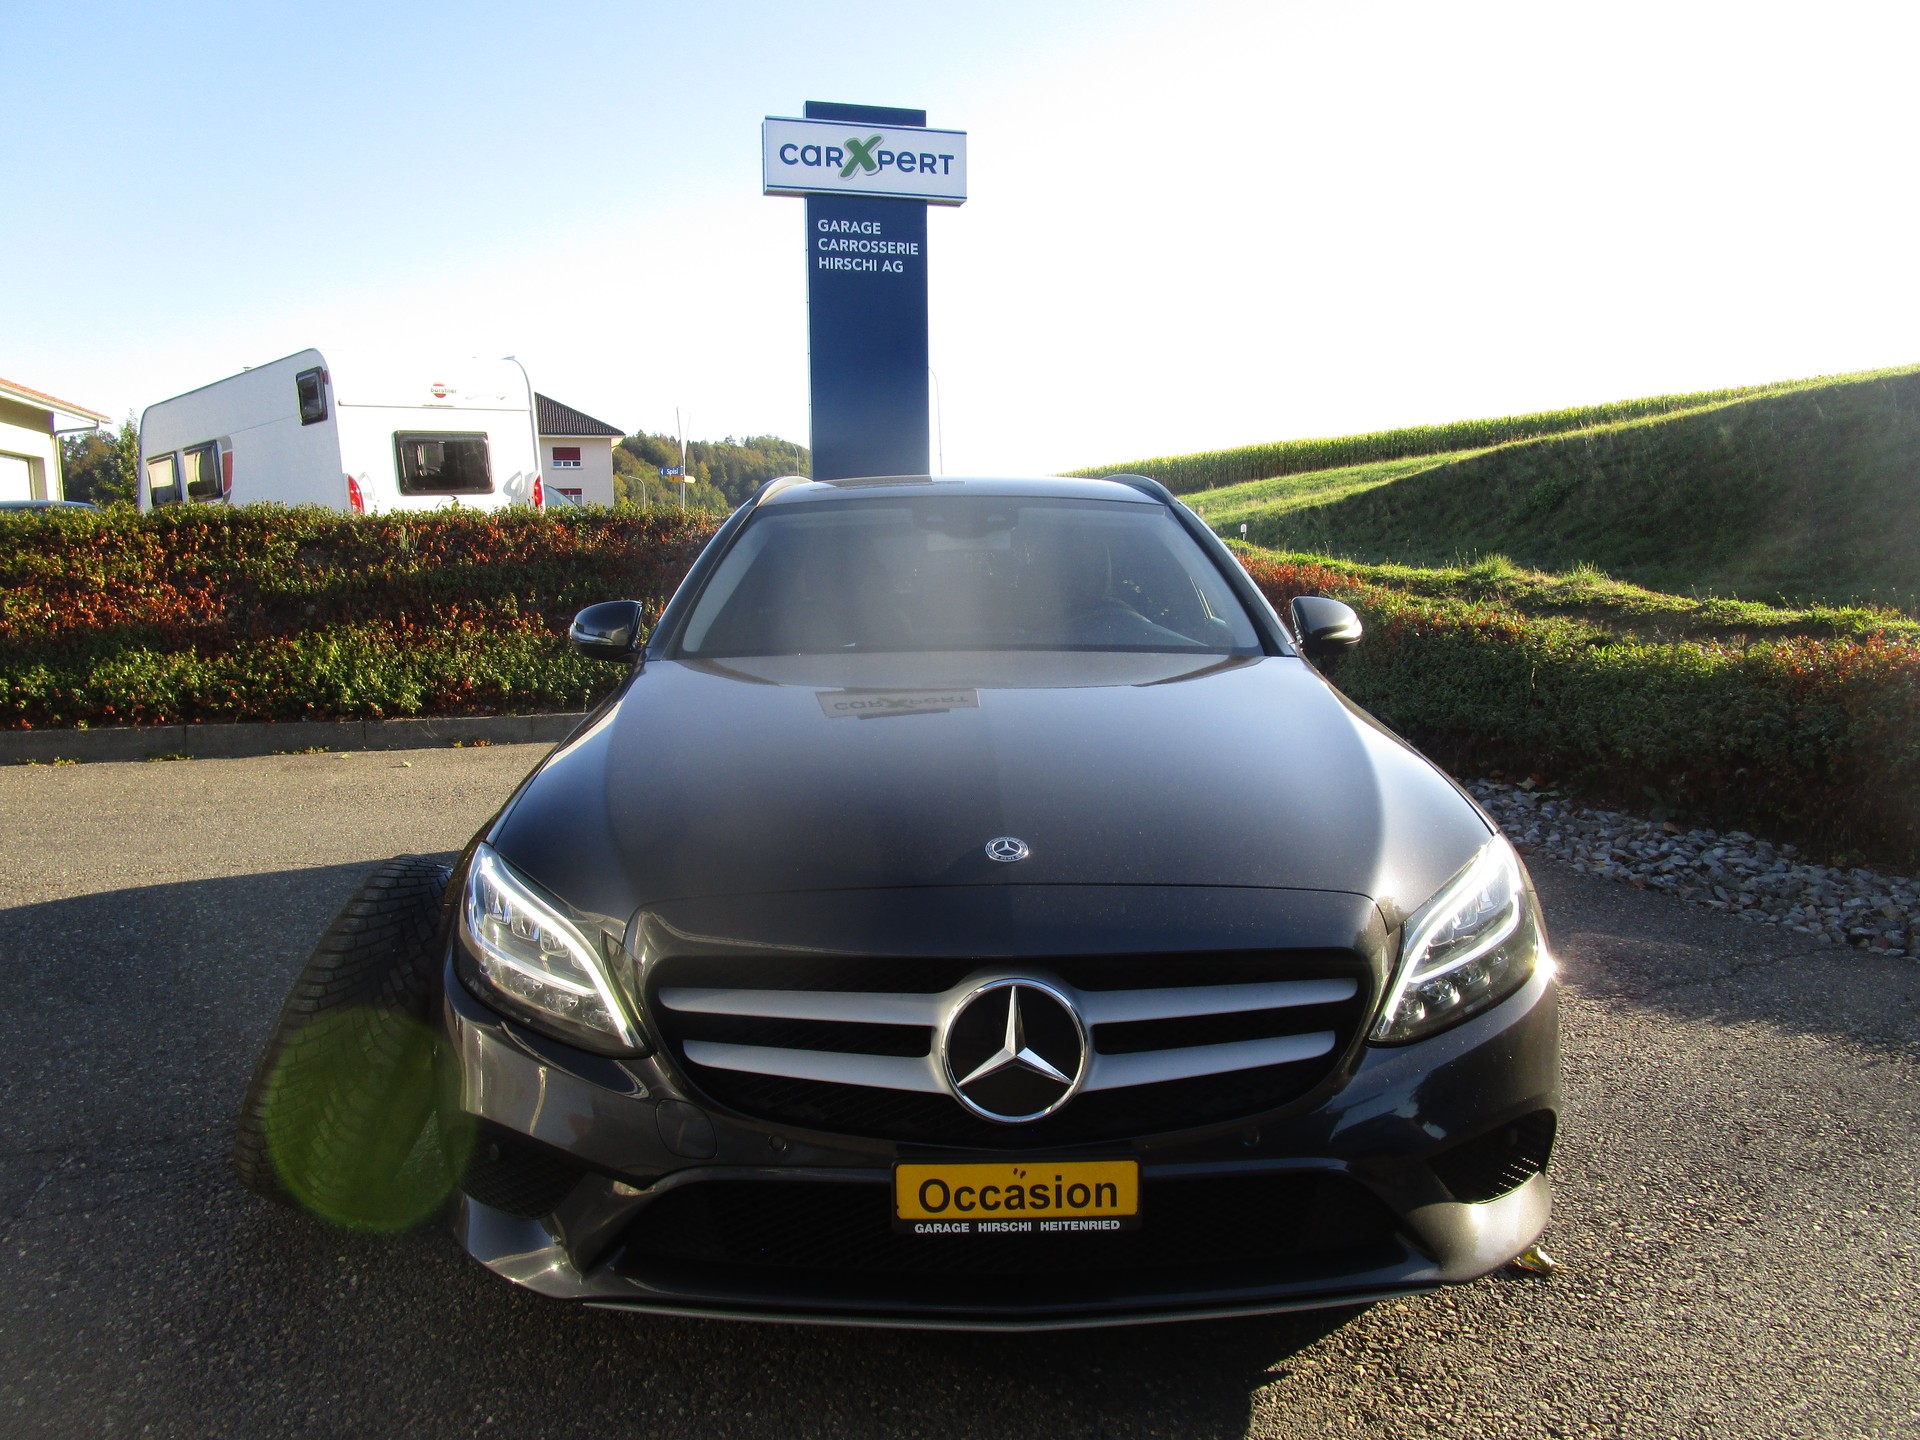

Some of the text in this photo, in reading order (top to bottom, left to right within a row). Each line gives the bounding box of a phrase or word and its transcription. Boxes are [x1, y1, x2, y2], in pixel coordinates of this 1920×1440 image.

[817, 219, 881, 235] GARAGE
[817, 238, 919, 255] CARROSSERIE
[818, 257, 904, 273] HIRSCHI AG
[918, 1174, 1118, 1213] Occasion
[914, 1220, 1121, 1234] GARAGE HIRSCHI HEITENRIED
